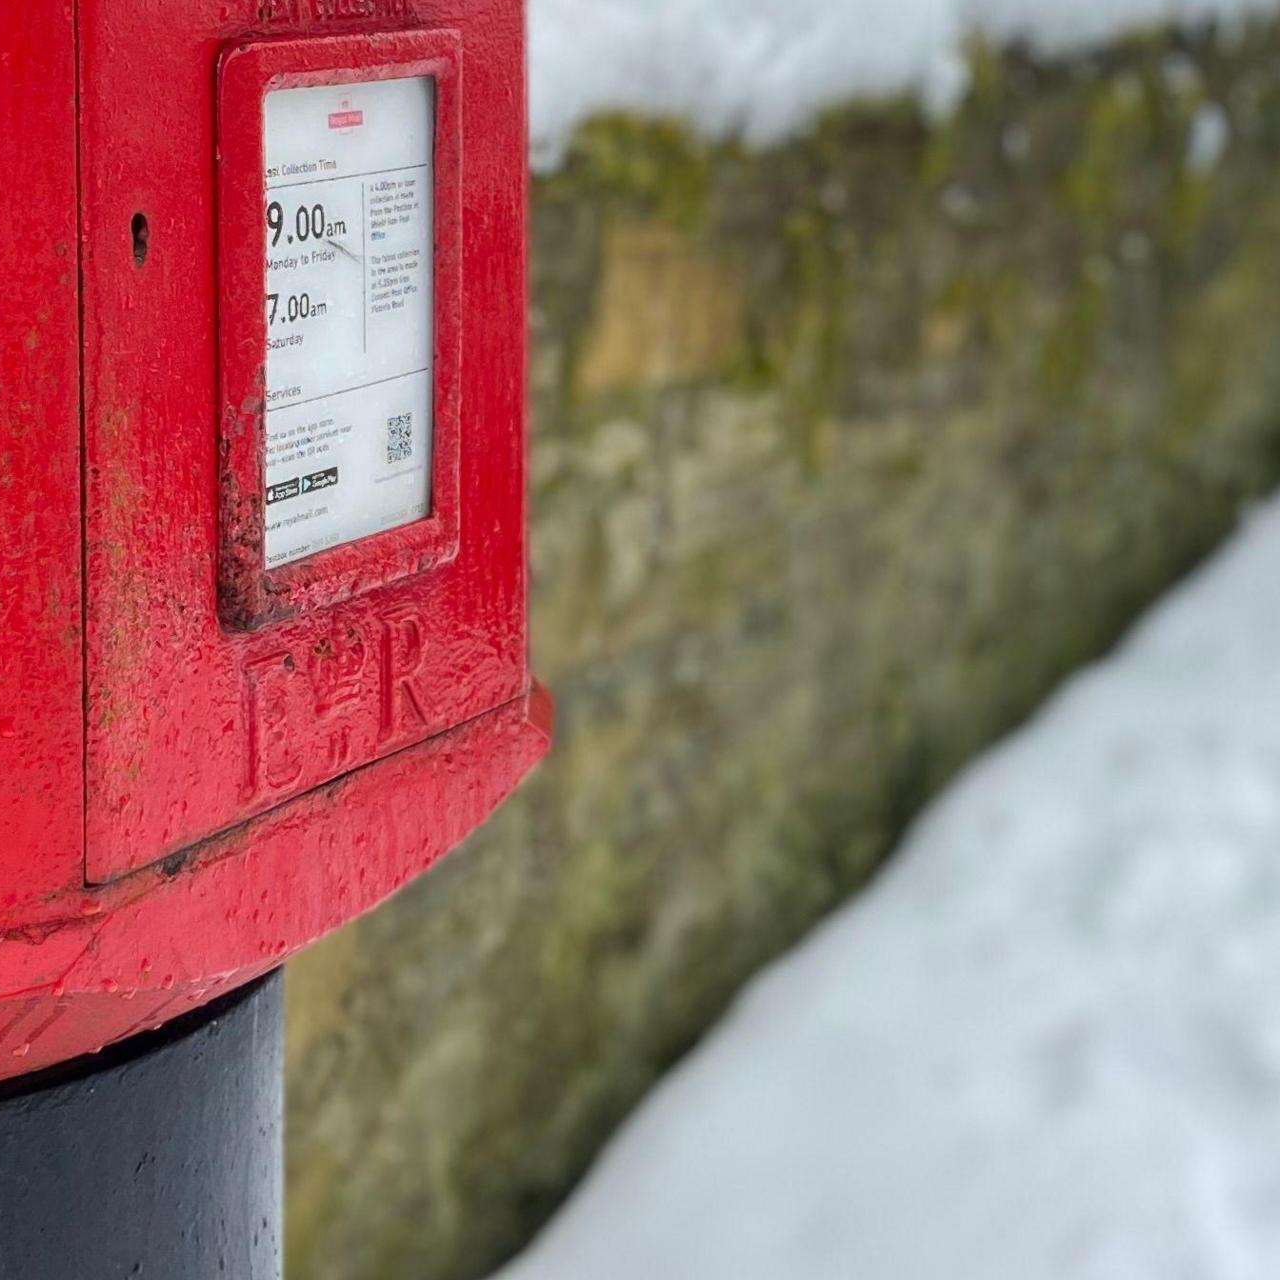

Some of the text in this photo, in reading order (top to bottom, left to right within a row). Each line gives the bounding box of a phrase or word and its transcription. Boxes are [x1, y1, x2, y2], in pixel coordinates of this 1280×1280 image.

[282, 160, 317, 176] Collection
[319, 158, 337, 171] Time
[266, 200, 347, 247] 9.00am
[266, 250, 336, 271] Monday to Friday
[266, 293, 327, 325] 7.00am
[266, 334, 304, 350] Saturday
[265, 385, 302, 402] Services
